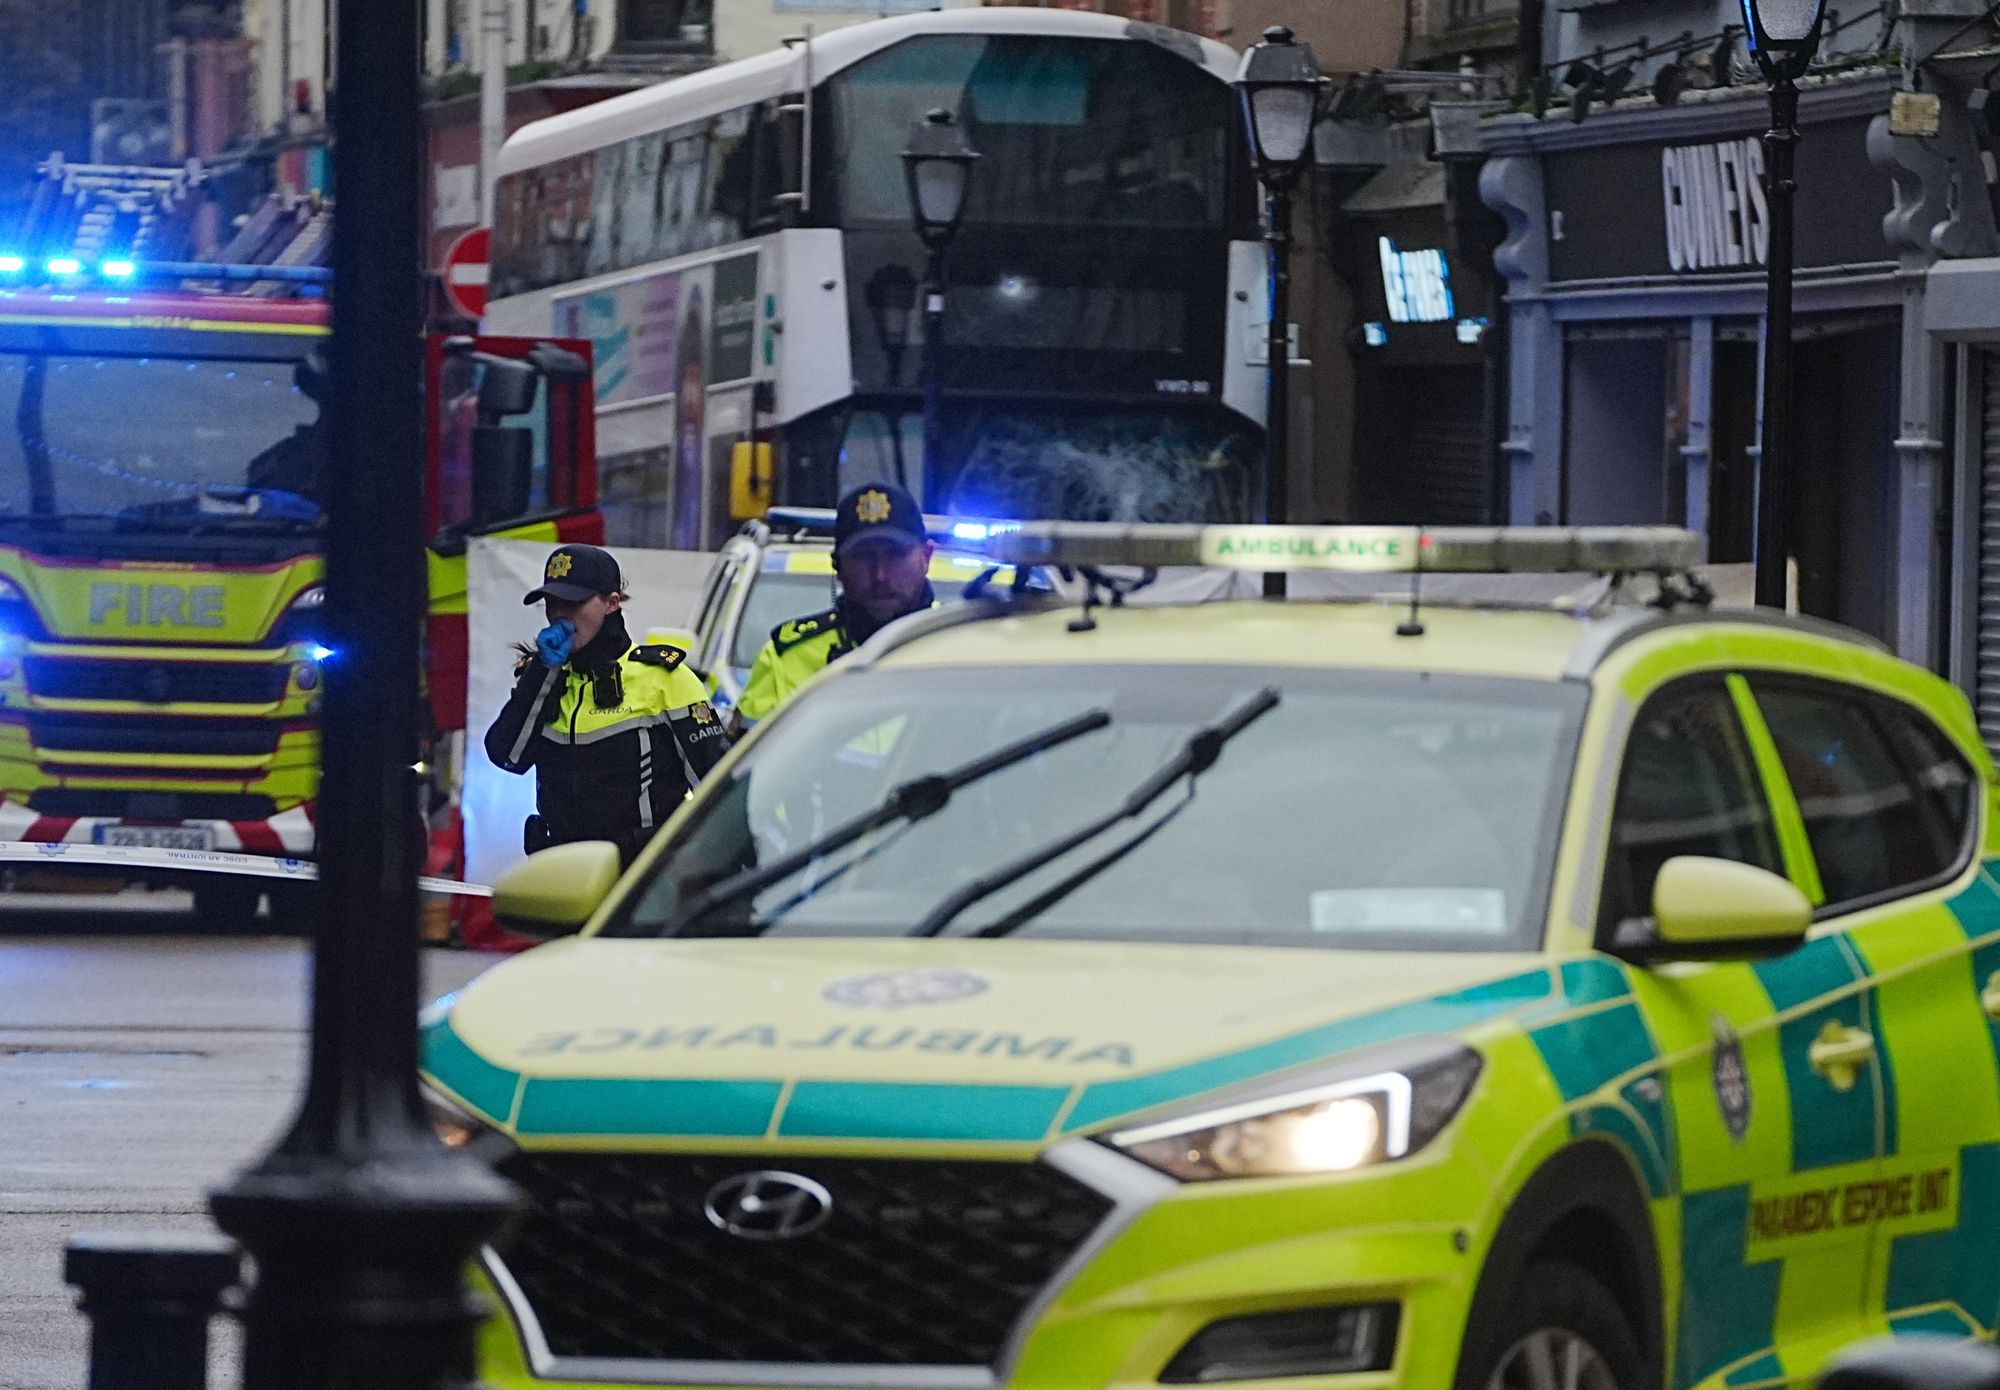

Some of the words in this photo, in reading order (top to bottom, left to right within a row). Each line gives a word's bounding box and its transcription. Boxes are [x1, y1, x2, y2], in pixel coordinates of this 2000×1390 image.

[1216, 536, 1401, 556] AMBULANCE
[89, 581, 225, 627] FIRE
[588, 706, 633, 716] GARDA
[689, 725, 725, 743] GARDA
